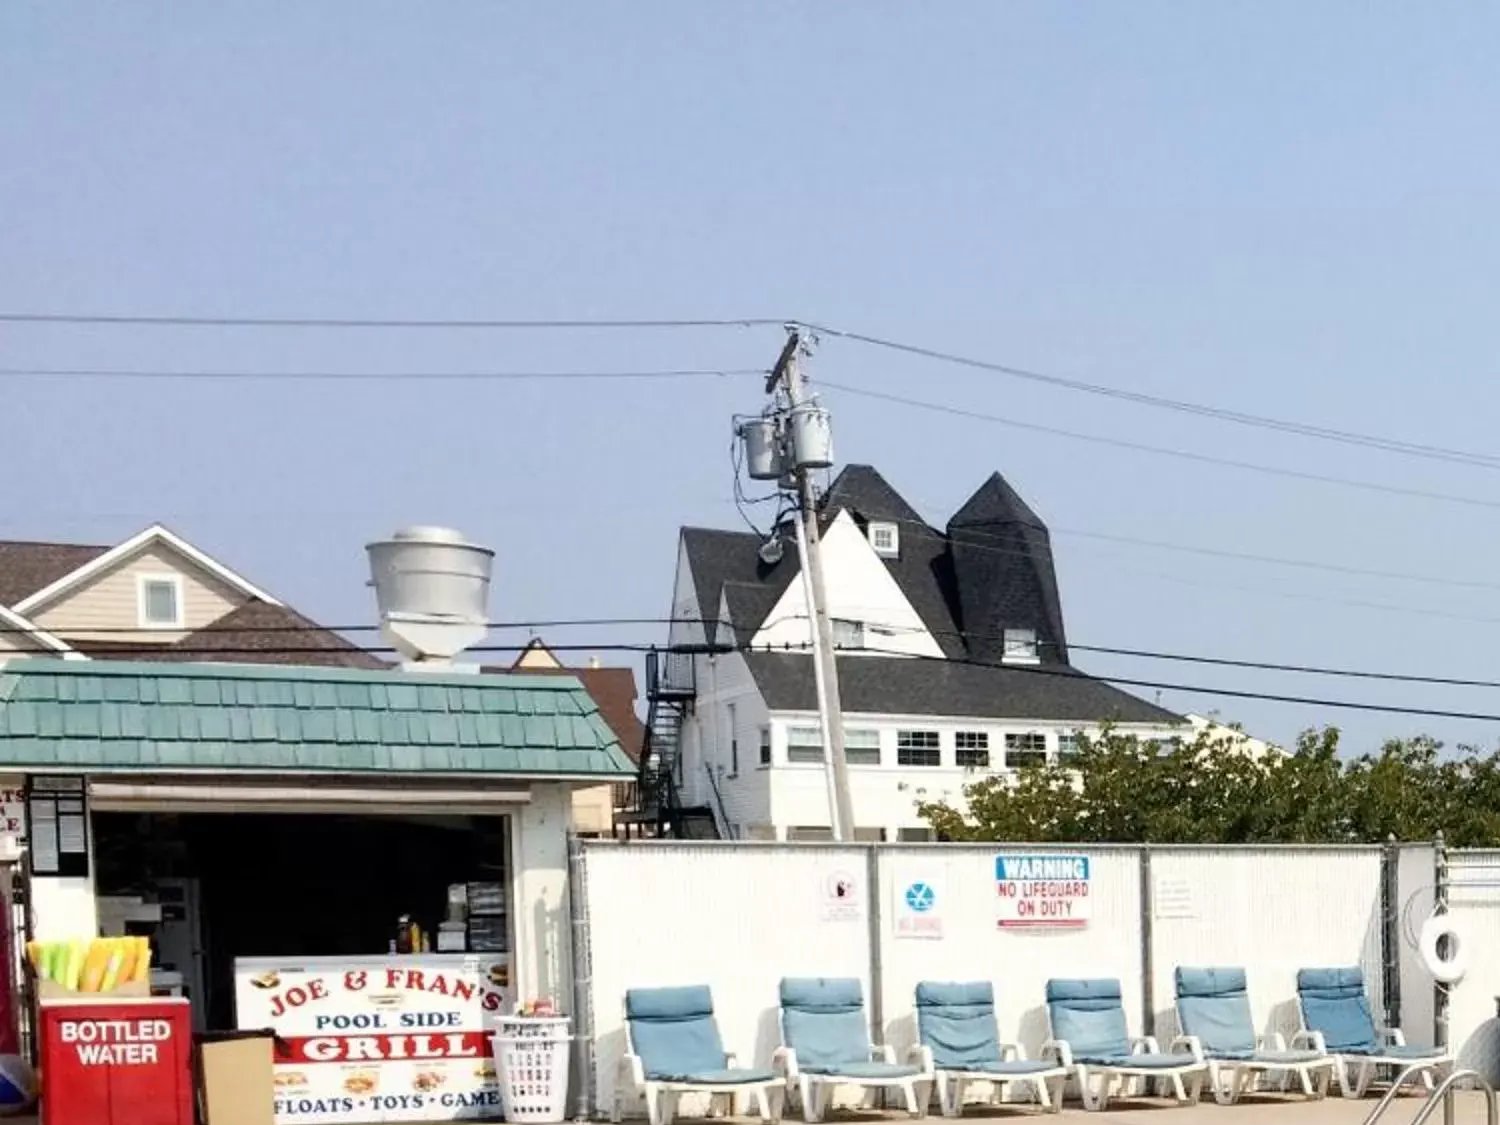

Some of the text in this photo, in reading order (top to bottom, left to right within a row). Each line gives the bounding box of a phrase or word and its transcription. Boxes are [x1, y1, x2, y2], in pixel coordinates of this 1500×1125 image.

[0, 789, 25, 803] TS
[1003, 857, 1086, 880] WARNING
[998, 881, 1088, 897] NO LIFEGUARD
[1017, 900, 1073, 917] ON DUTY
[271, 967, 503, 1017] JOE & FRAN'S
[316, 1010, 462, 1030] POOL SIDE
[61, 1020, 171, 1042] BOTTLED
[76, 1044, 158, 1065] WATER
[302, 1035, 478, 1062] GRILL
[273, 1091, 501, 1115] FLOATS TOYS GAME
